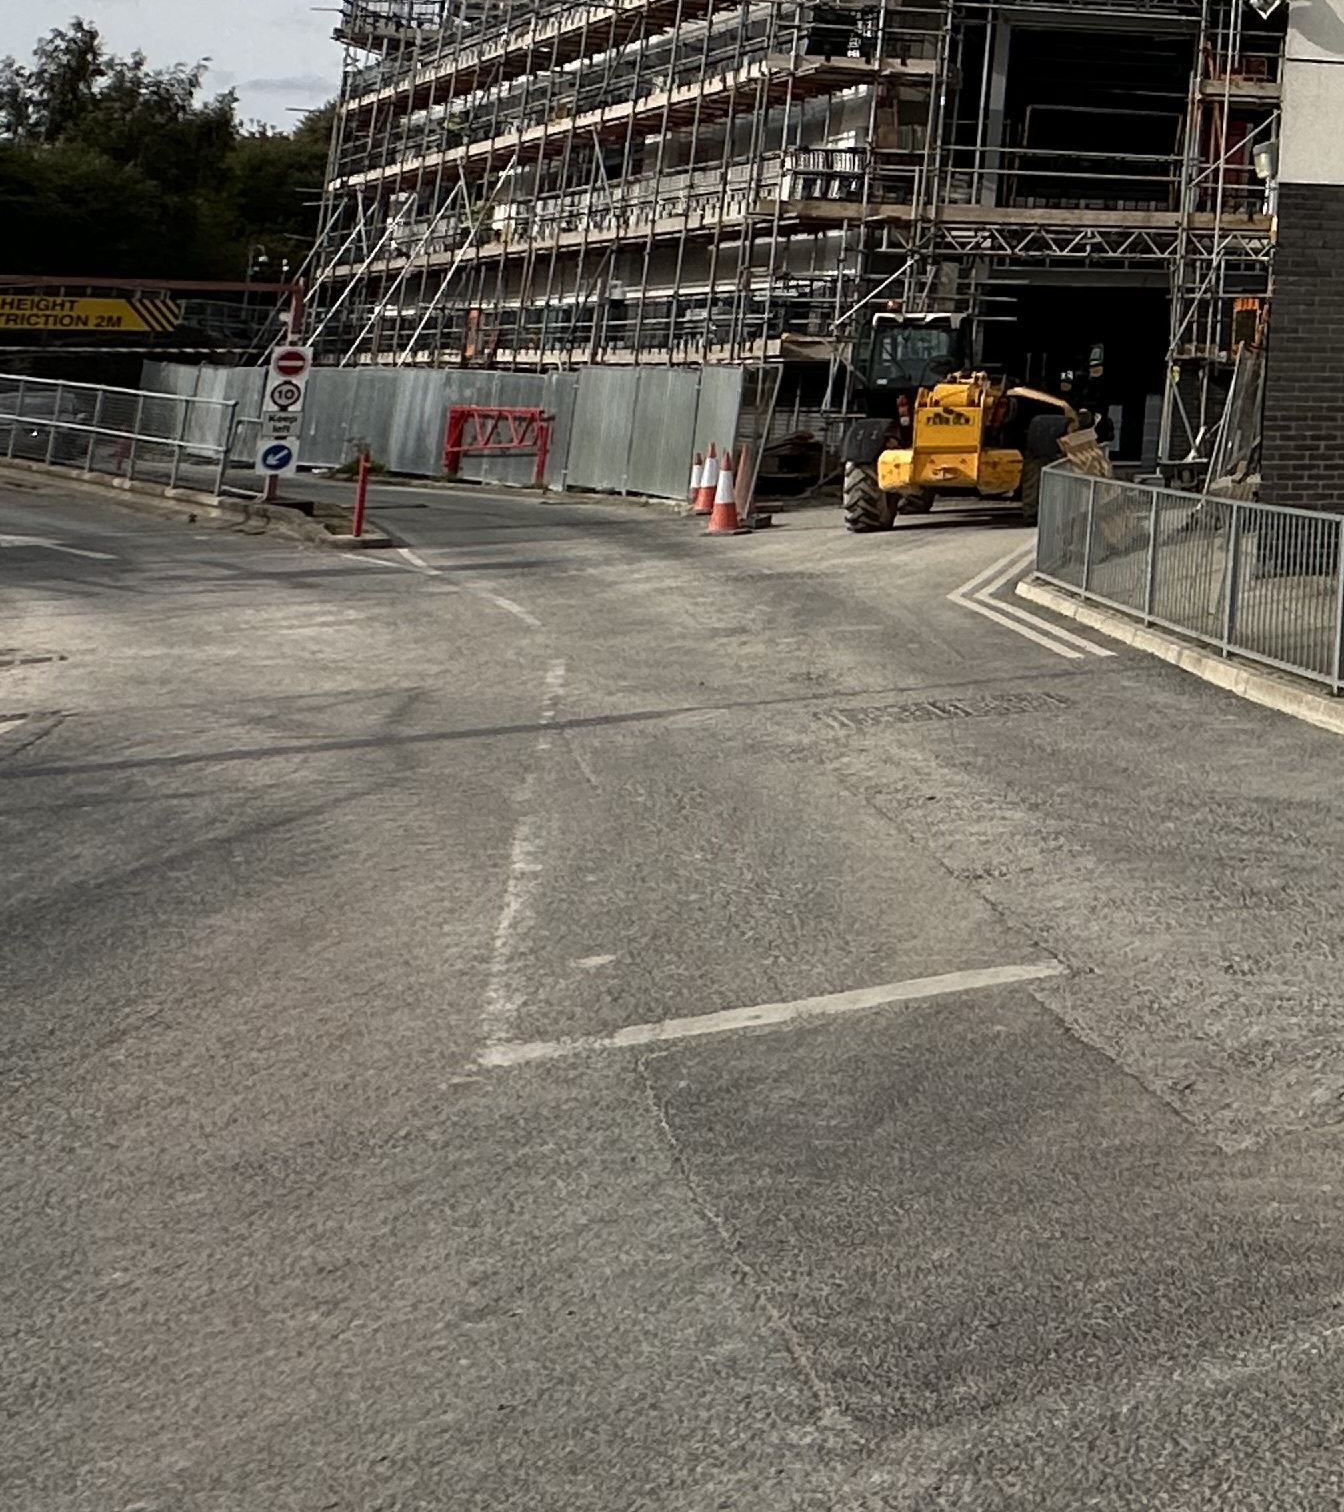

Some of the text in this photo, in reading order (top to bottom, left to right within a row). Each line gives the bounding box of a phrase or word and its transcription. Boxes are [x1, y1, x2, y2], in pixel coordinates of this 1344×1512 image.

[0, 298, 78, 311] HEIGHT
[94, 315, 122, 328] 2M
[276, 389, 294, 400] 10
[268, 414, 298, 424] Keep
[273, 424, 291, 433] left
